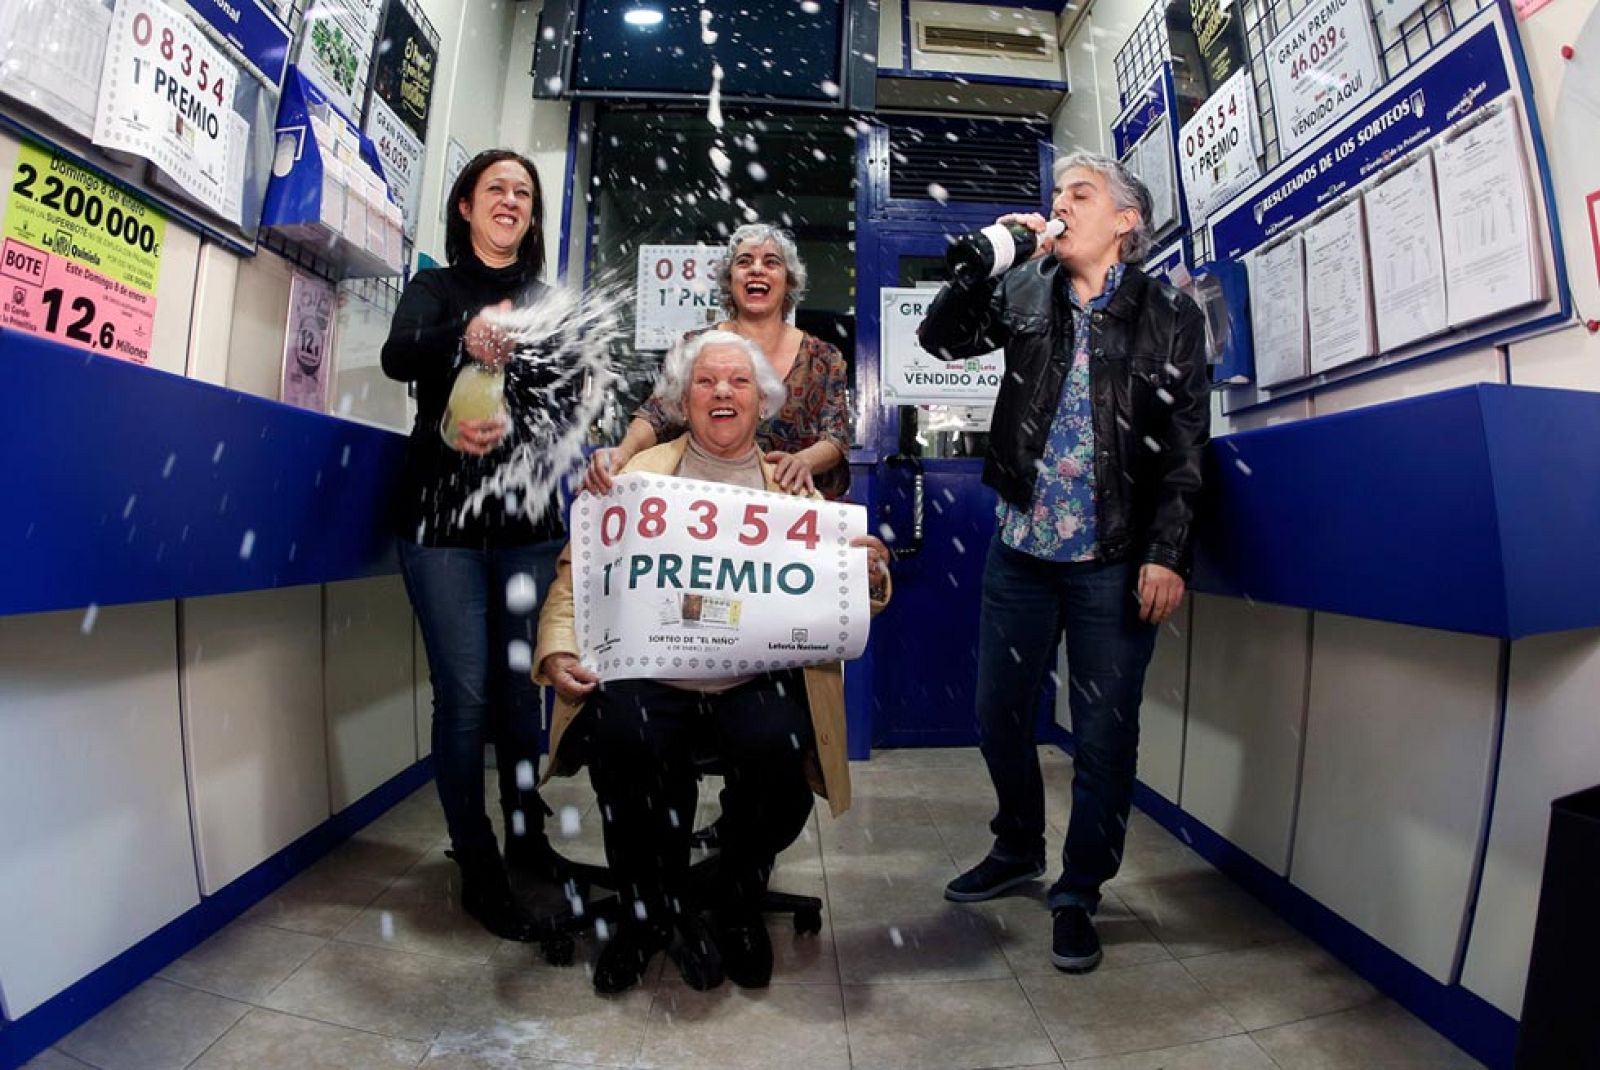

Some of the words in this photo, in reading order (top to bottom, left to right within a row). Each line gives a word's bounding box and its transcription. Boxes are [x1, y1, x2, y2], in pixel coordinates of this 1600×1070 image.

[1279, 30, 1306, 64] GRAN
[1308, 0, 1347, 36] PREMIO
[132, 12, 225, 106] 08354
[1291, 26, 1336, 80] 46.039
[155, 67, 218, 139] PREMIO
[1292, 98, 1334, 137] VENDIDO
[1186, 94, 1237, 157] 08354
[1199, 127, 1239, 176] PREMIO
[1262, 163, 1317, 211] RESULTADOS
[1318, 154, 1333, 173] DE
[1335, 137, 1356, 162] LOS
[1357, 98, 1410, 146] SORTEOS
[51, 158, 99, 190] Domingo
[6, 249, 42, 277] BOTE
[65, 262, 83, 277] Este
[84, 268, 115, 291] Domingo
[655, 257, 718, 281] 083
[678, 288, 720, 306] PRE
[115, 338, 148, 359] Millones
[904, 373, 971, 385] VENDIDO
[976, 374, 1003, 386] AQ
[600, 497, 820, 550] 08354
[628, 553, 816, 596] PREMIO
[647, 634, 682, 644] SORTEO
[683, 634, 694, 644] DE
